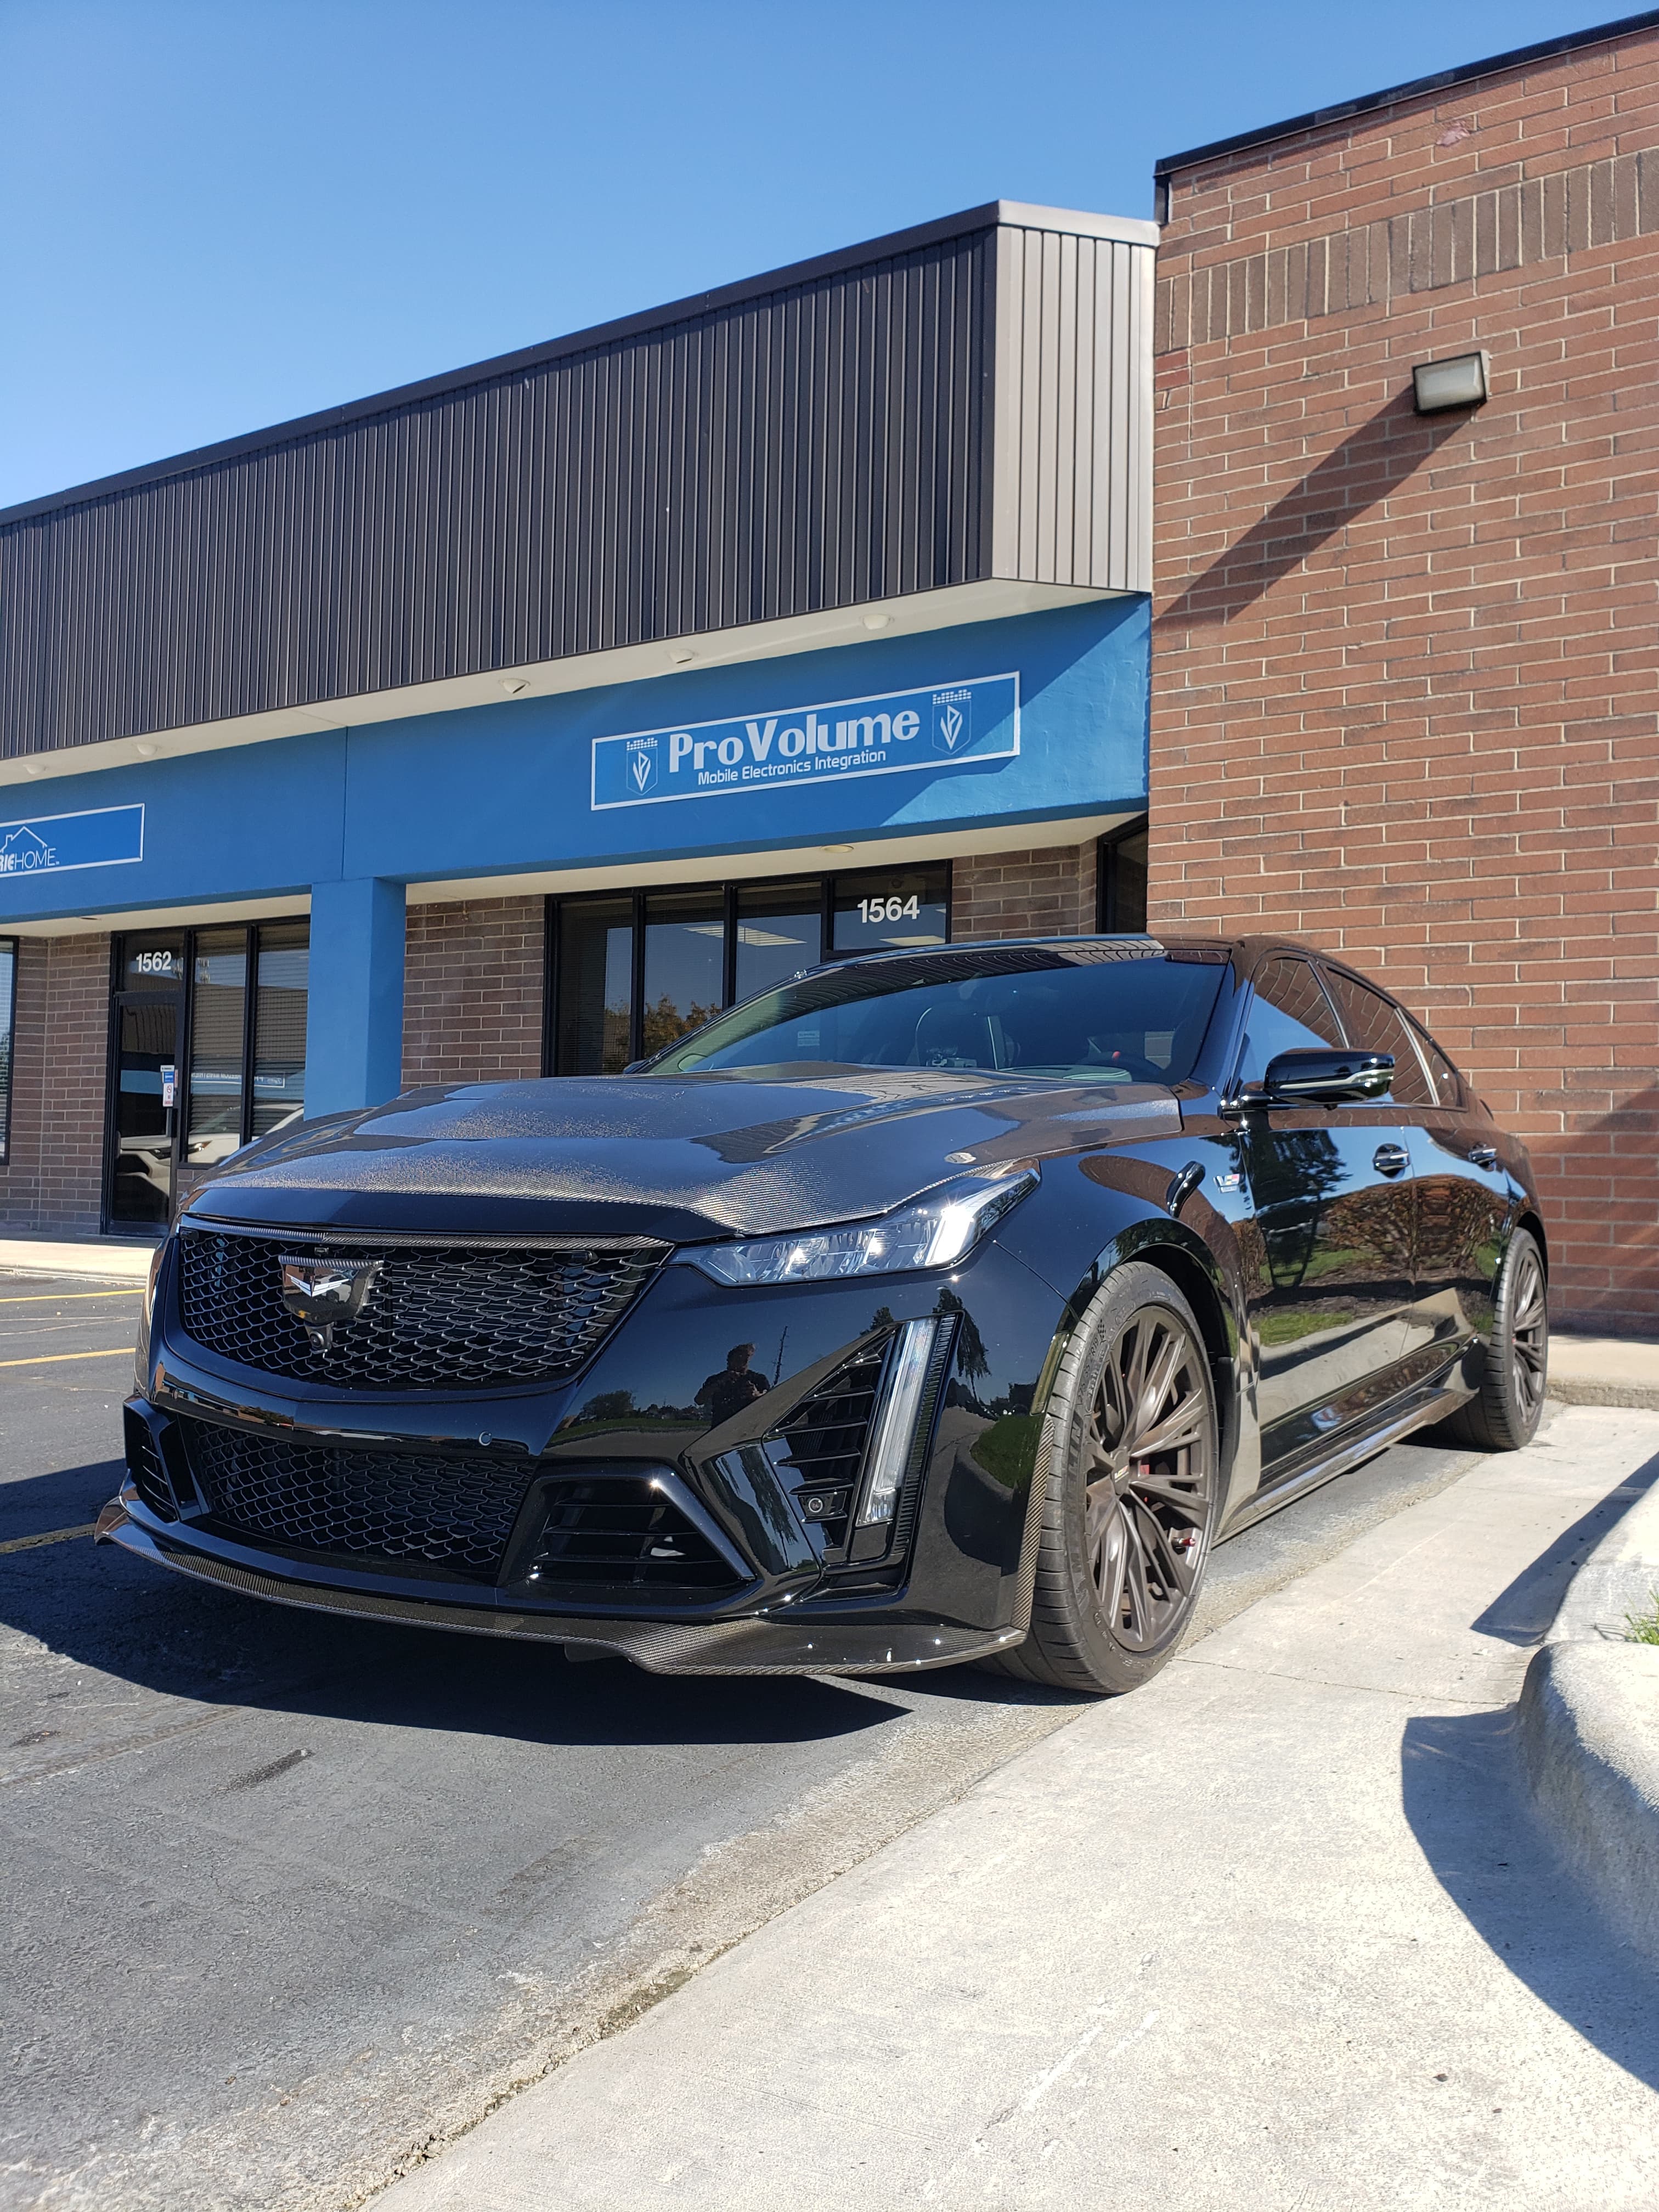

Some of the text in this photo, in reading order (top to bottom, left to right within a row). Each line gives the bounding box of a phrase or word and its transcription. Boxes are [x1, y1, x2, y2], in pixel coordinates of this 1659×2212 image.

[669, 710, 921, 773] ProVolume
[698, 750, 886, 785] Mobile Electronics Integration
[857, 895, 920, 923] 1564
[136, 951, 171, 972] 1562
